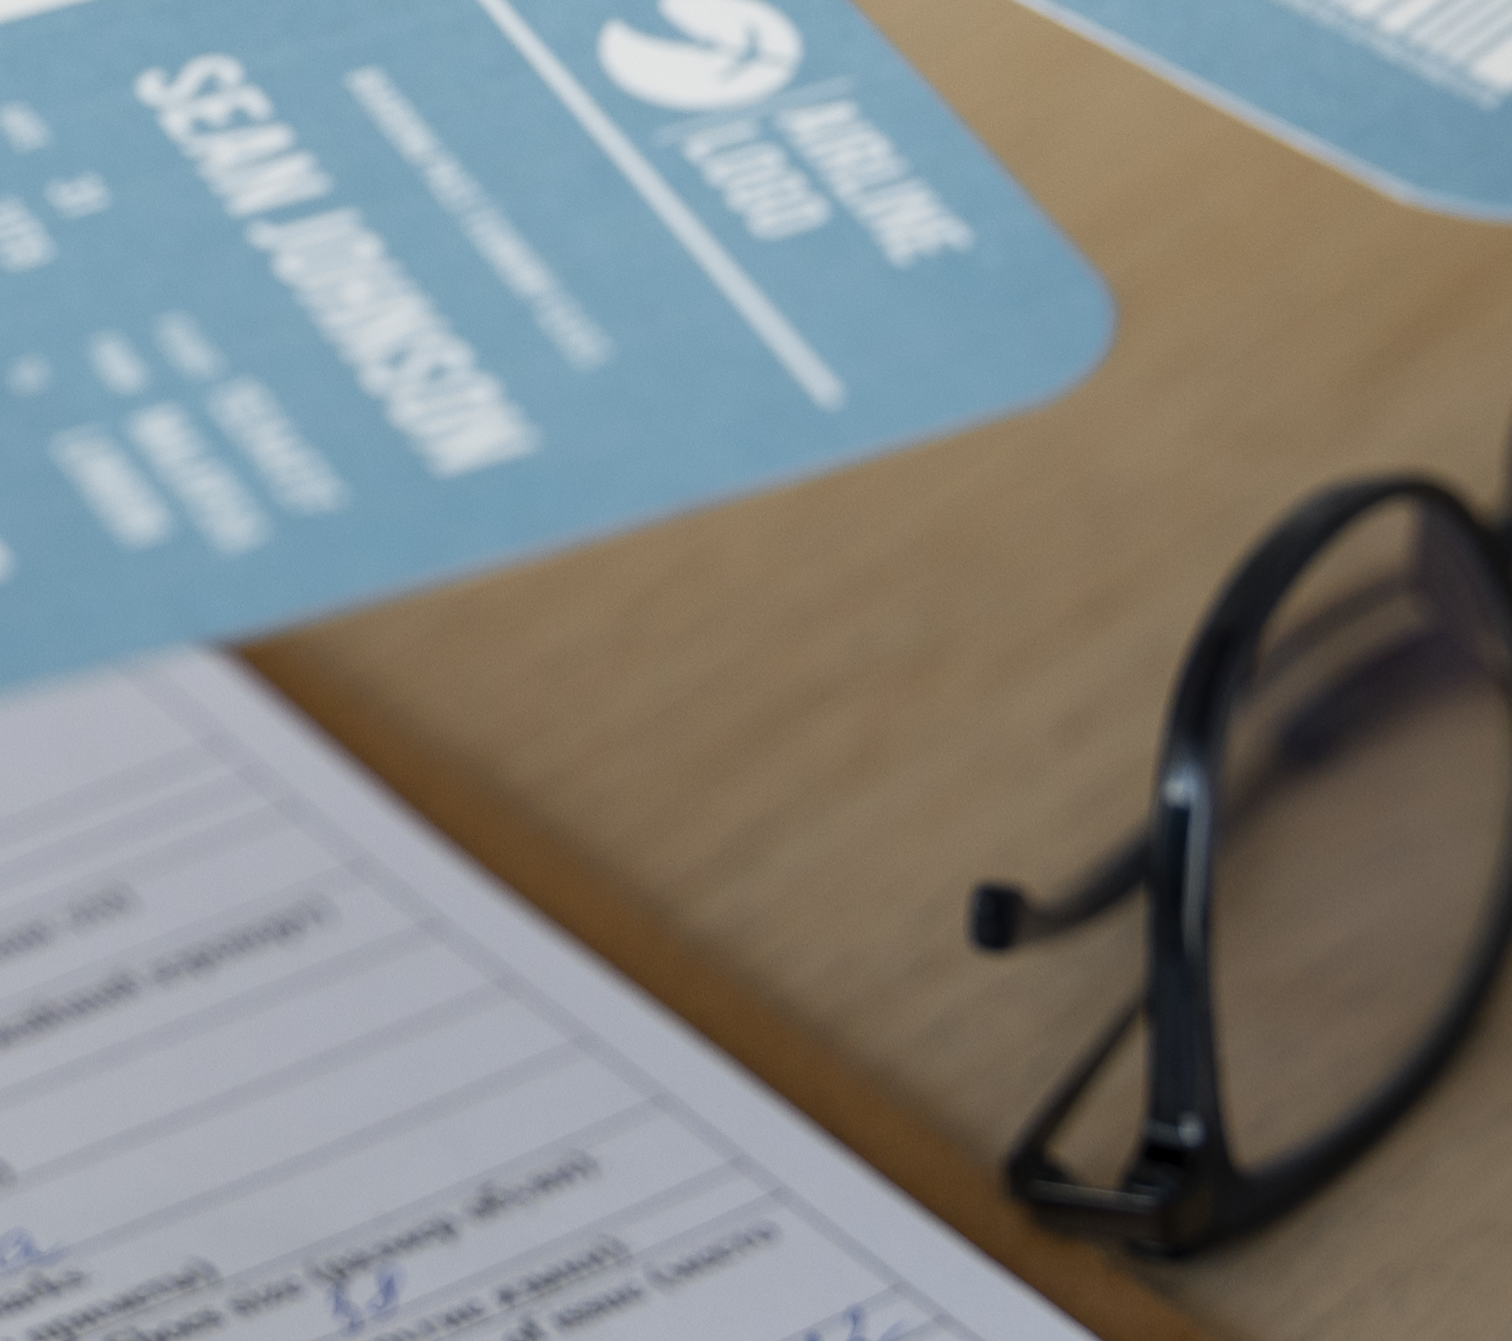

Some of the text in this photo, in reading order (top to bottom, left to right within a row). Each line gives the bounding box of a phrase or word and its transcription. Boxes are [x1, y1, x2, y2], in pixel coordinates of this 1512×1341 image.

[682, 117, 833, 242] LOGO
[779, 97, 976, 269] AIRLINE
[132, 53, 334, 219] SEAN
[243, 204, 543, 480] JOHNSON
